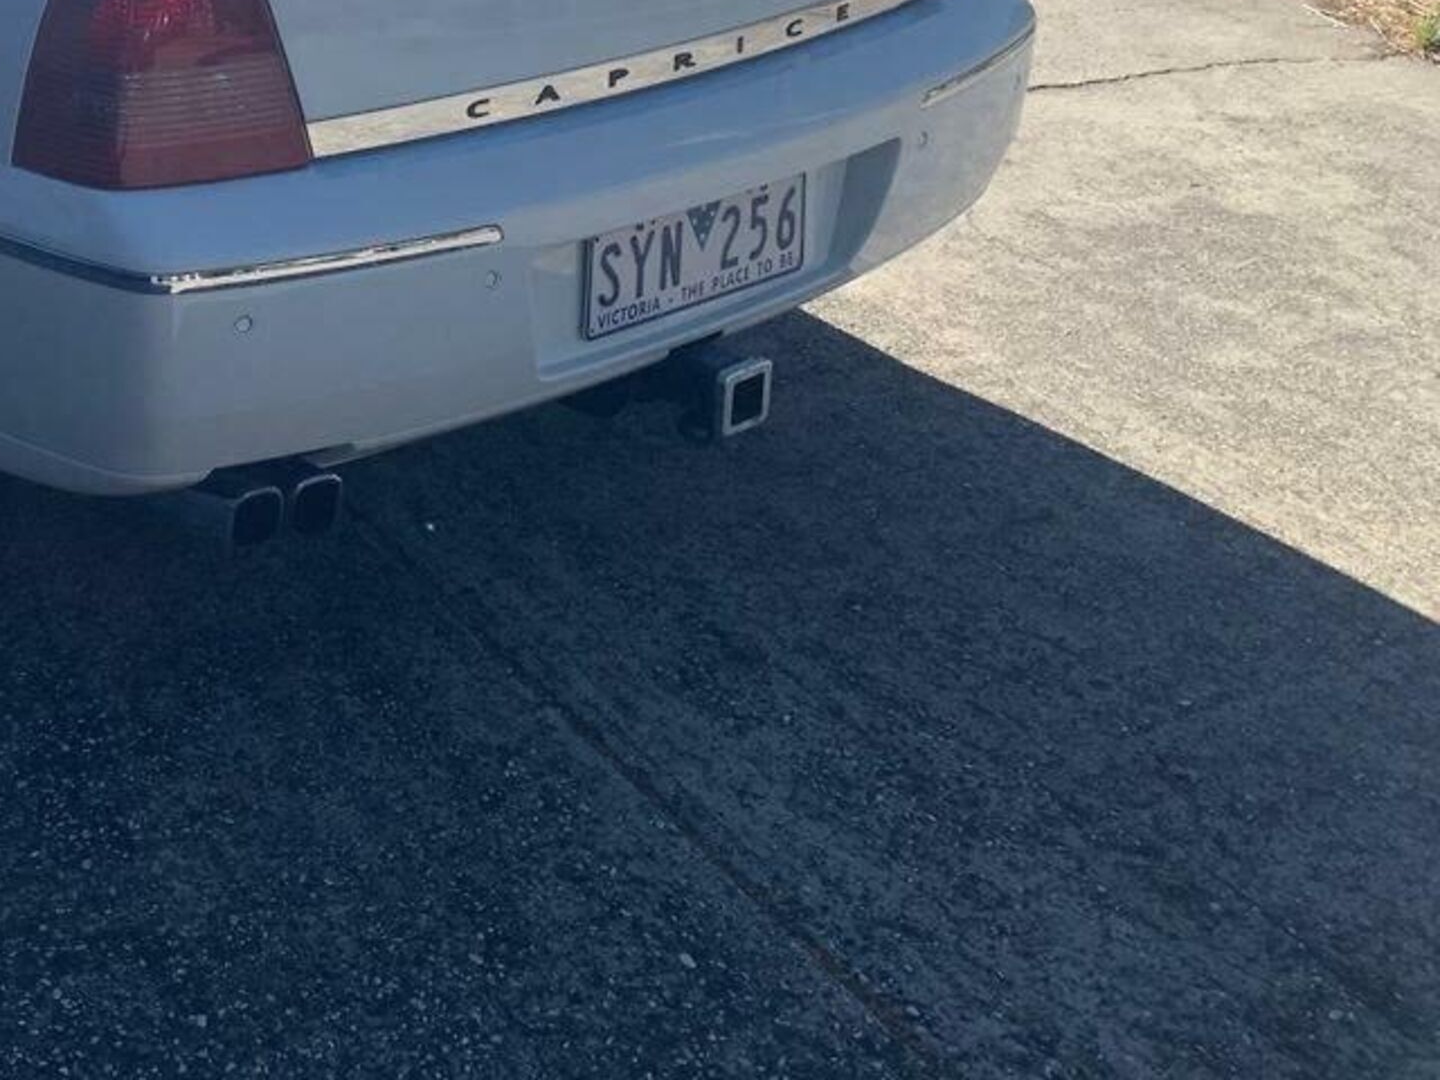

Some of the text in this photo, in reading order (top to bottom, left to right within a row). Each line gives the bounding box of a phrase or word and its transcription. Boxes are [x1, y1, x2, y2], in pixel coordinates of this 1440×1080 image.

[466, 3, 850, 119] CAPRICE
[596, 297, 661, 329] VICTORIA
[681, 282, 706, 302] THE
[711, 266, 750, 292] PLACE
[756, 257, 773, 276] TO
[597, 186, 797, 308] SYN 256
